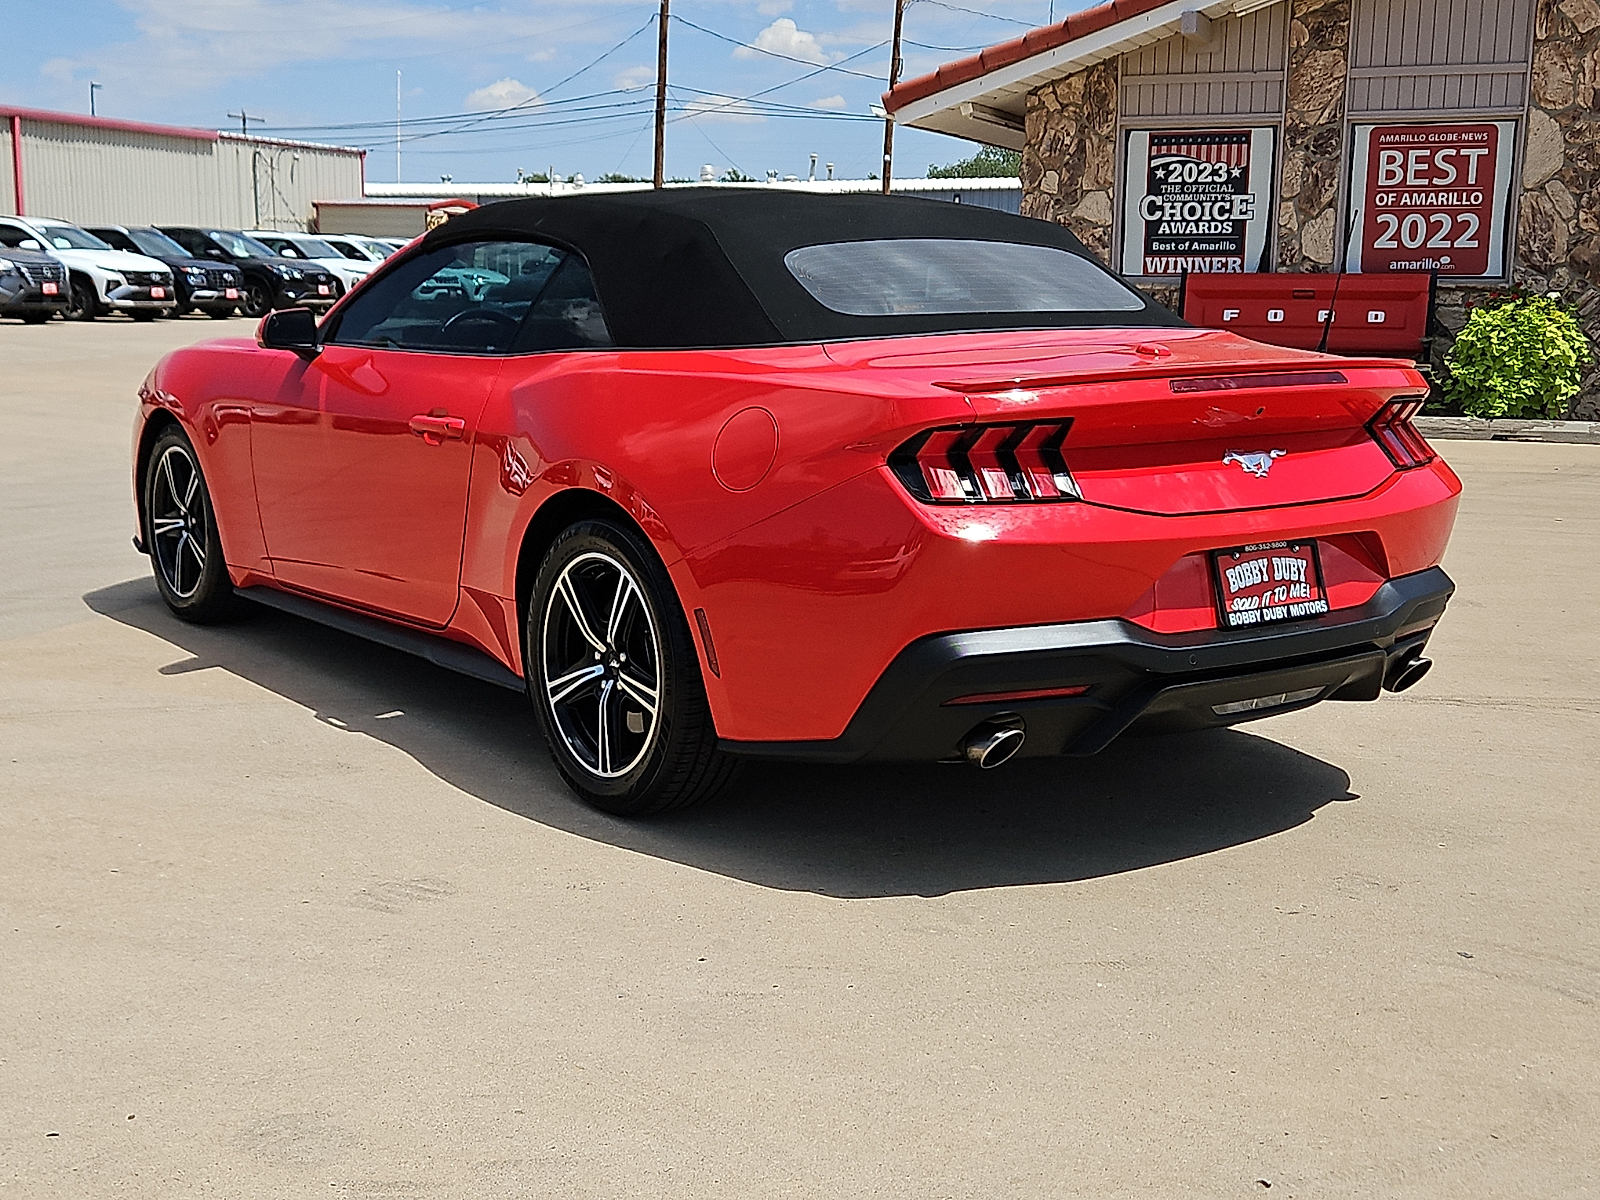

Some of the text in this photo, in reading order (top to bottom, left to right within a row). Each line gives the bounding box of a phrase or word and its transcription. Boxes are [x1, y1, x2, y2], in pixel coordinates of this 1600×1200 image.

[1379, 134, 1426, 143] AMARILLO
[1167, 162, 1228, 183] 2023
[1377, 148, 1489, 186] BEST
[1160, 184, 1235, 193] THE OFFICIAL
[1164, 193, 1231, 202] COMMUNITY'S
[1141, 194, 1254, 221] CHOICE
[1375, 191, 1483, 206] OF AMARILLO
[1157, 221, 1233, 234] AWARDS
[1373, 213, 1480, 249] 2022
[1152, 241, 1236, 251] Best of Amarillo
[1145, 256, 1243, 274] WINNER
[1223, 308, 1386, 323] FORD
[1226, 557, 1307, 593] BOBBY DUBY
[1230, 583, 1310, 611] SOLD IT TO ME!
[1228, 600, 1328, 626] BOBBY DUBY MOTORS
